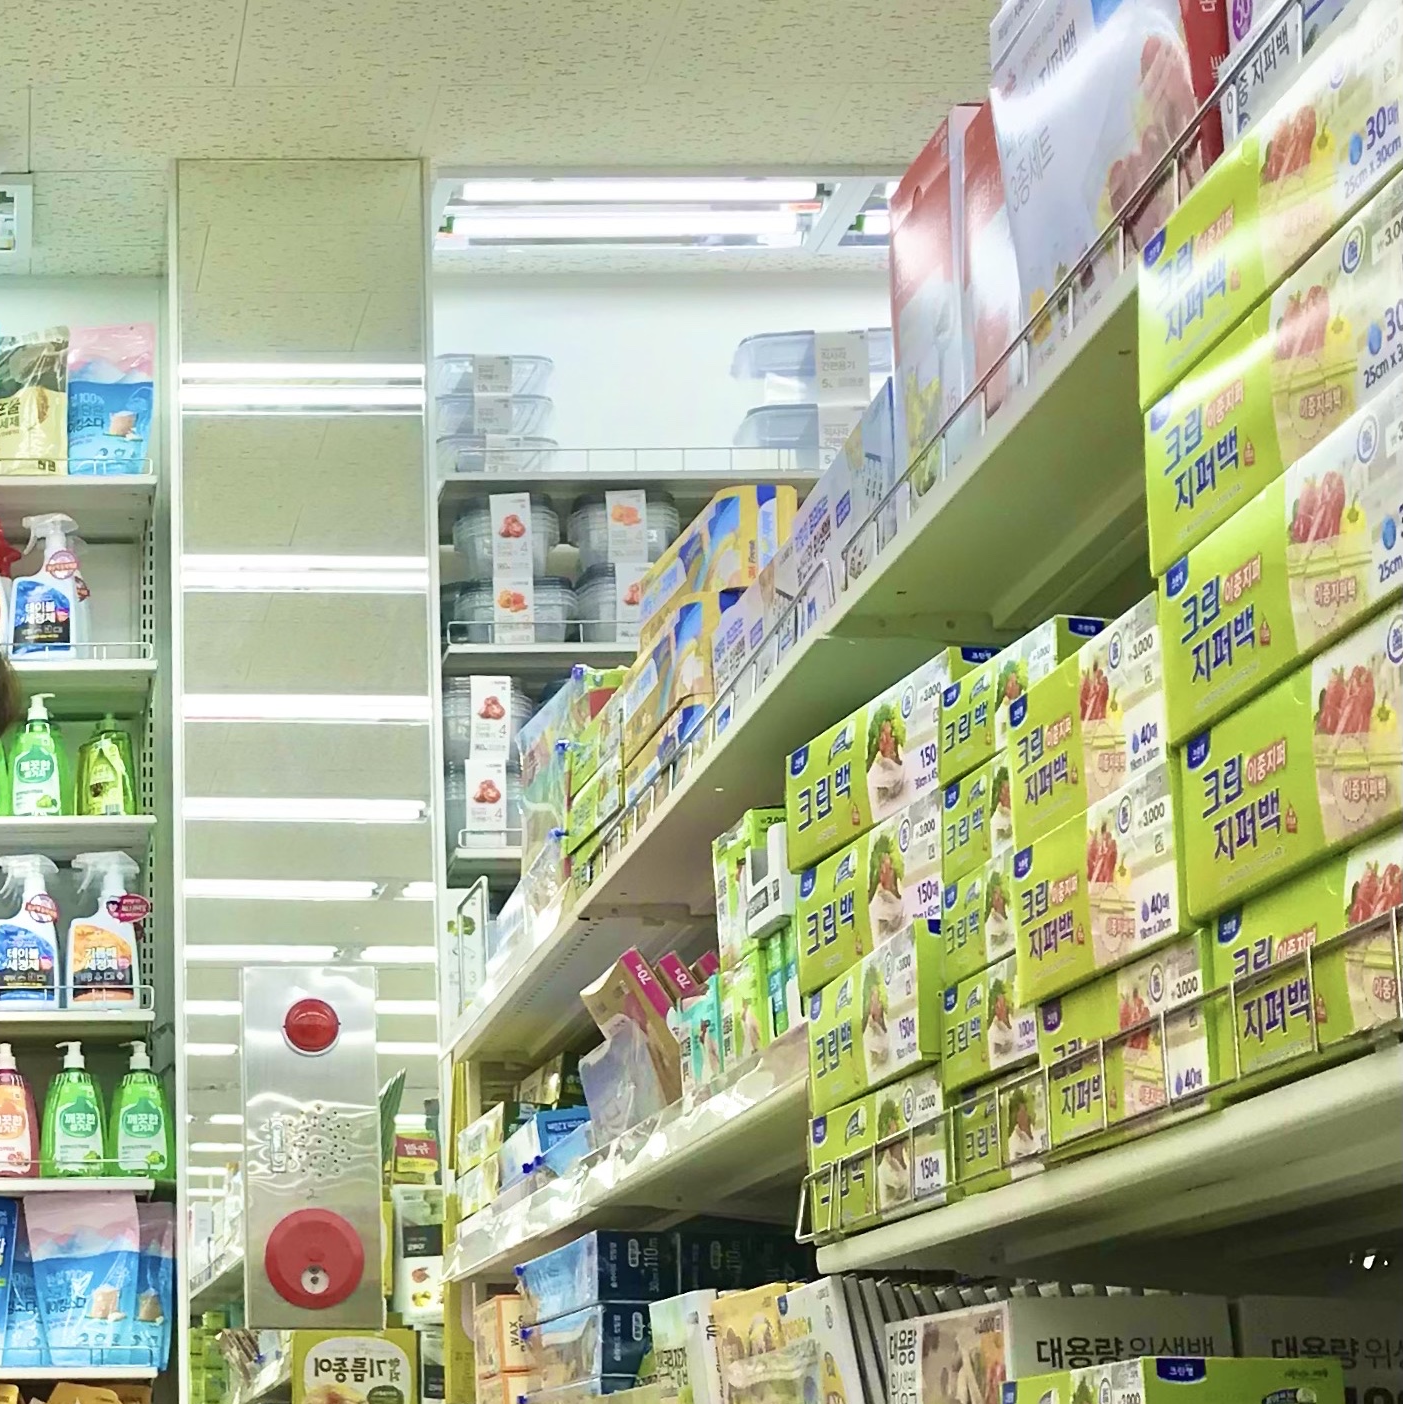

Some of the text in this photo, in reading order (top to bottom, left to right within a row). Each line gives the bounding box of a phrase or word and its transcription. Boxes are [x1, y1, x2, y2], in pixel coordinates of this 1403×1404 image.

[1164, 403, 1203, 476] 크린
[1175, 426, 1239, 512] 지퍼백
[1181, 553, 1262, 645] 크린 이중지퍼
[1192, 603, 1256, 686] 지퍼백
[943, 700, 989, 754] 크린백
[1017, 724, 1044, 773] 크린
[797, 760, 852, 833] 크린백
[1024, 752, 1069, 805] 지퍼백
[1202, 737, 1287, 819] 크린 이중지퍼
[1342, 776, 1388, 801] 이중지퍼백
[1213, 788, 1282, 863] 지퍼백
[806, 889, 855, 955] 크린백
[1021, 879, 1049, 927] 크린
[7, 946, 39, 960] 테이블
[85, 947, 117, 959] 기름때
[1028, 910, 1074, 961] 지퍼백
[5, 958, 40, 971] 세정제
[85, 958, 118, 971] 세정제
[1243, 975, 1312, 1045] 지퍼백
[816, 1018, 853, 1079] 크린백
[64, 1111, 96, 1125] 깨끗한
[127, 1112, 159, 1125] 깨끗한
[889, 1328, 917, 1365] 대용량
[1036, 1335, 1123, 1368] 대용량
